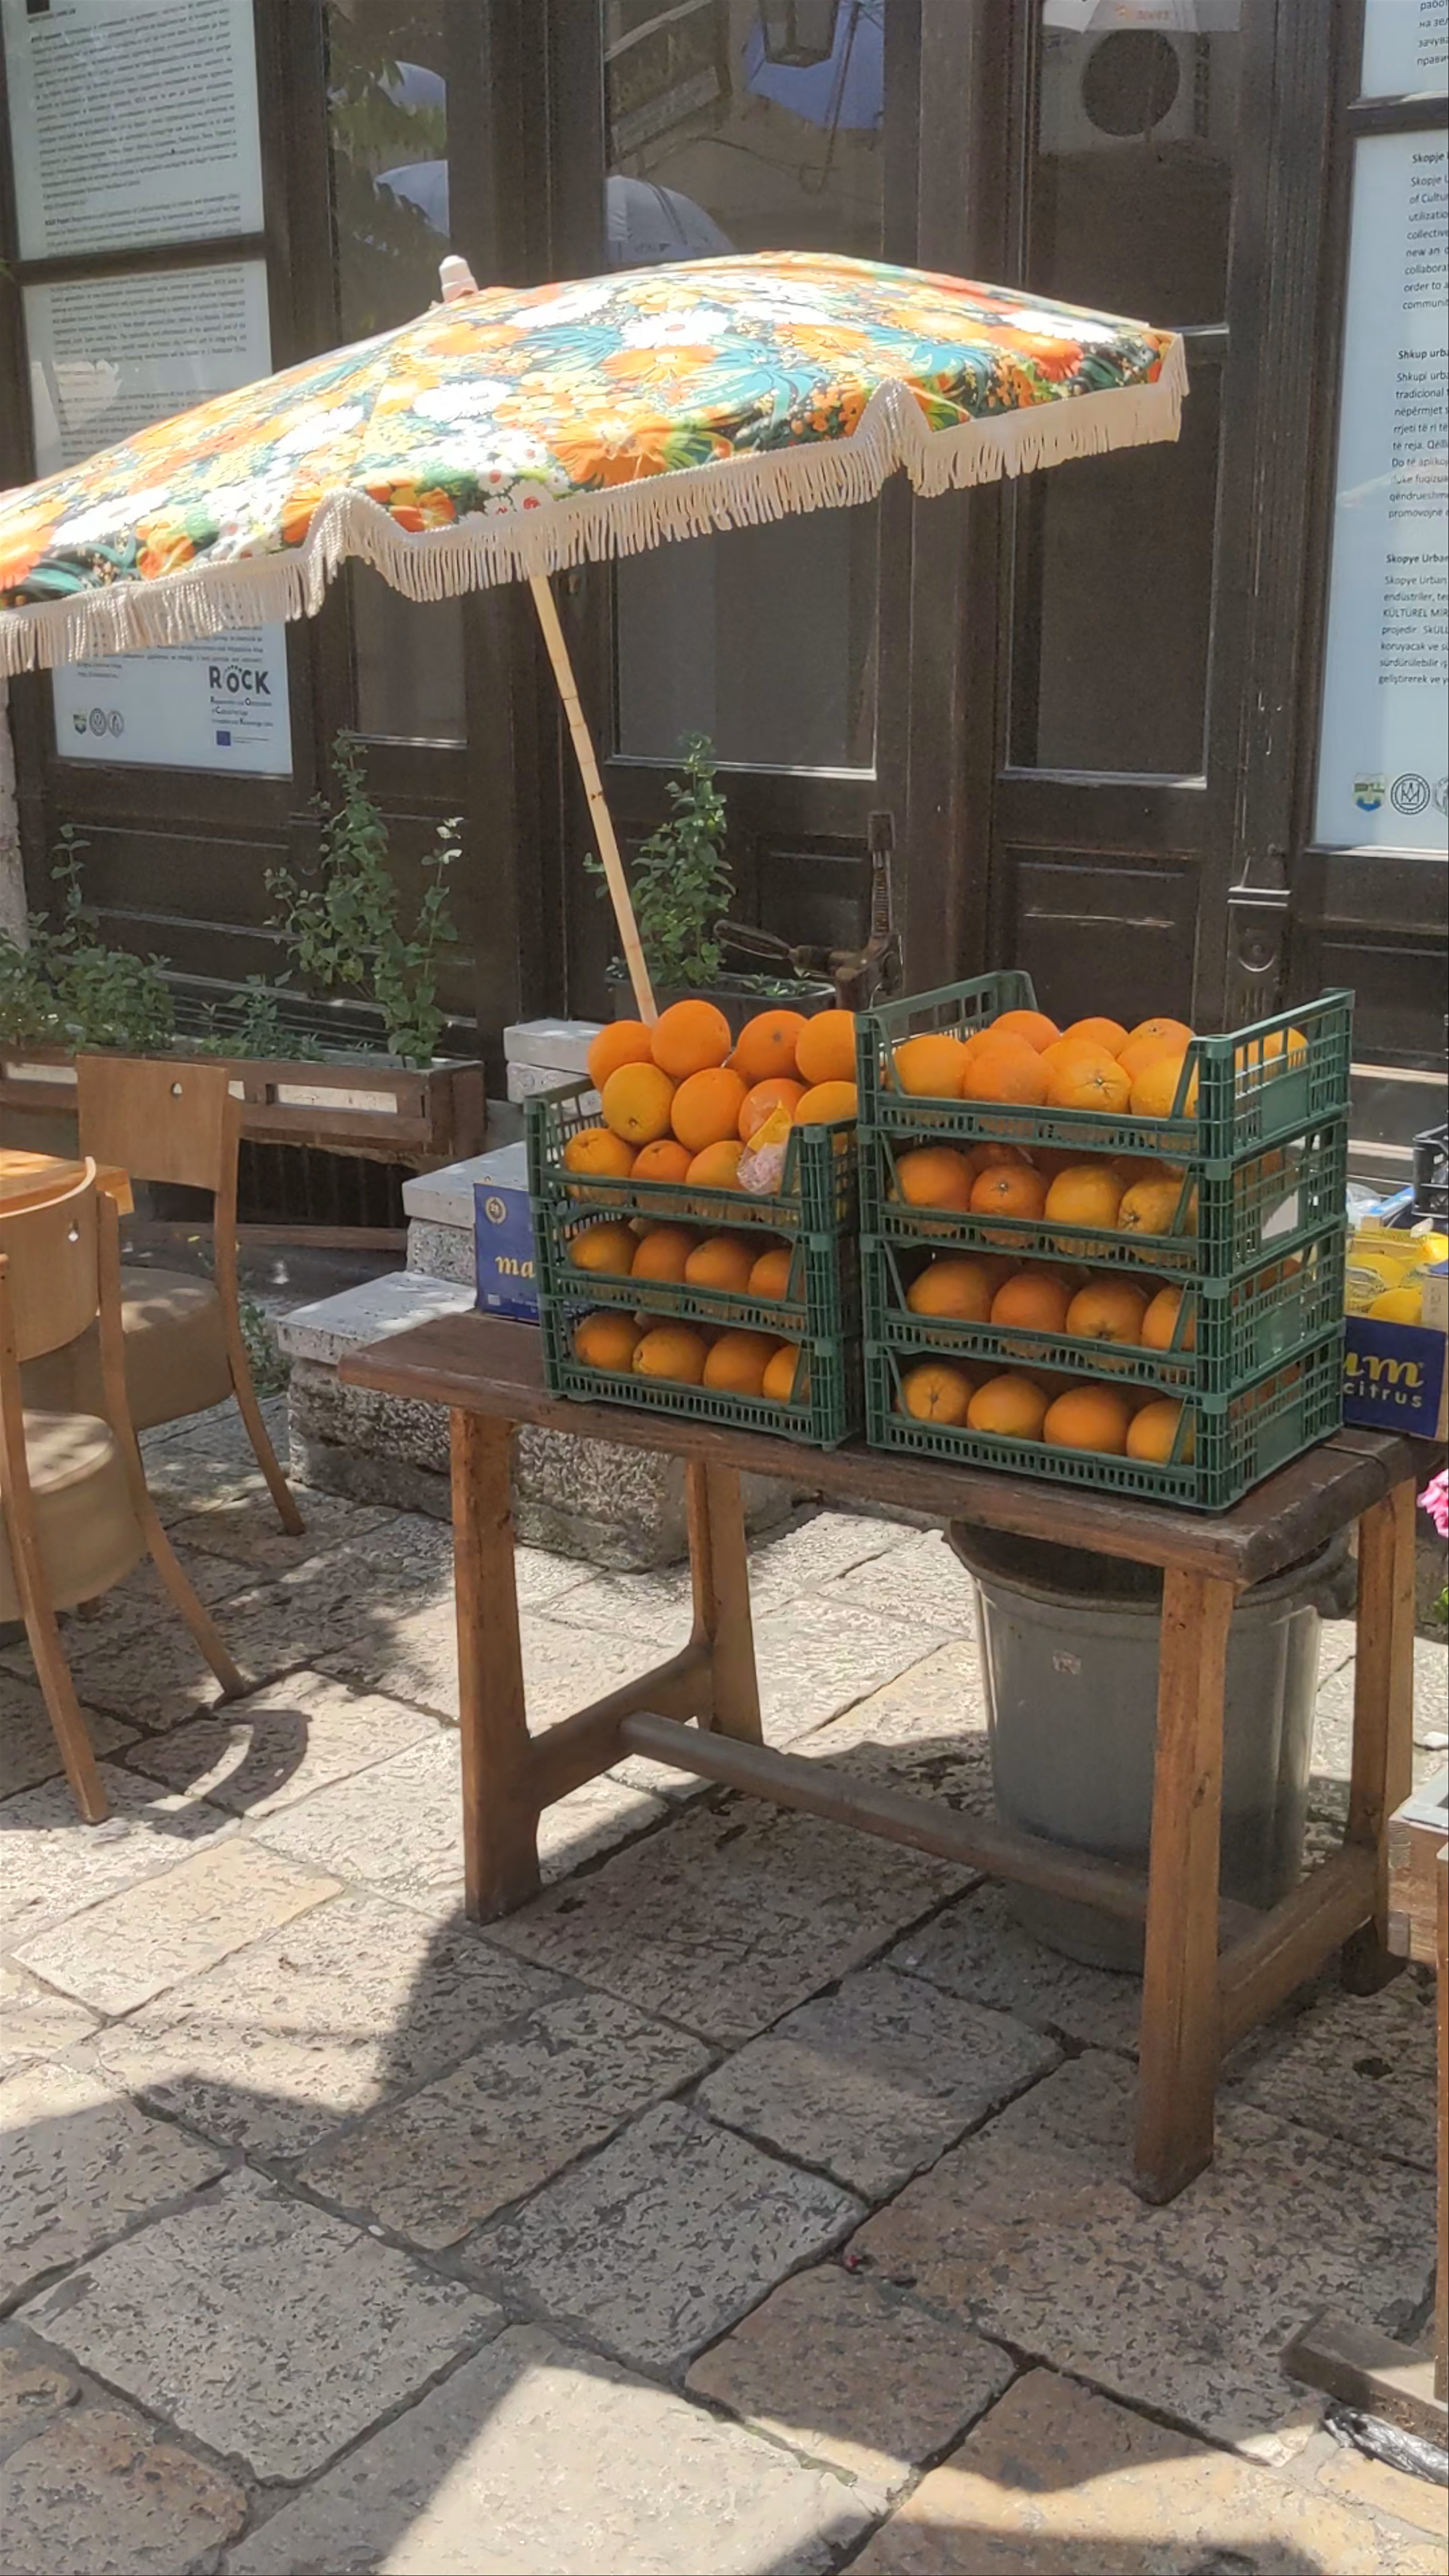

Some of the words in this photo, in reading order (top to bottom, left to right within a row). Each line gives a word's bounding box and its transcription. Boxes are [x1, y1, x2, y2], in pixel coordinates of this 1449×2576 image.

[1412, 152, 1444, 164] Skopje
[1411, 175, 1442, 187] Skopje
[1409, 194, 1419, 204] of
[1406, 249, 1426, 257] new
[1405, 265, 1449, 275] collabora
[1404, 283, 1429, 292] order
[1398, 350, 1427, 360] Shkup
[1397, 372, 1427, 383] Shkupi
[1396, 388, 1444, 399] tradicional
[1392, 458, 1404, 467] Do
[1386, 554, 1419, 564] Skopye
[1385, 575, 1417, 586] Skopye
[1343, 1380, 1423, 1408] citrus
